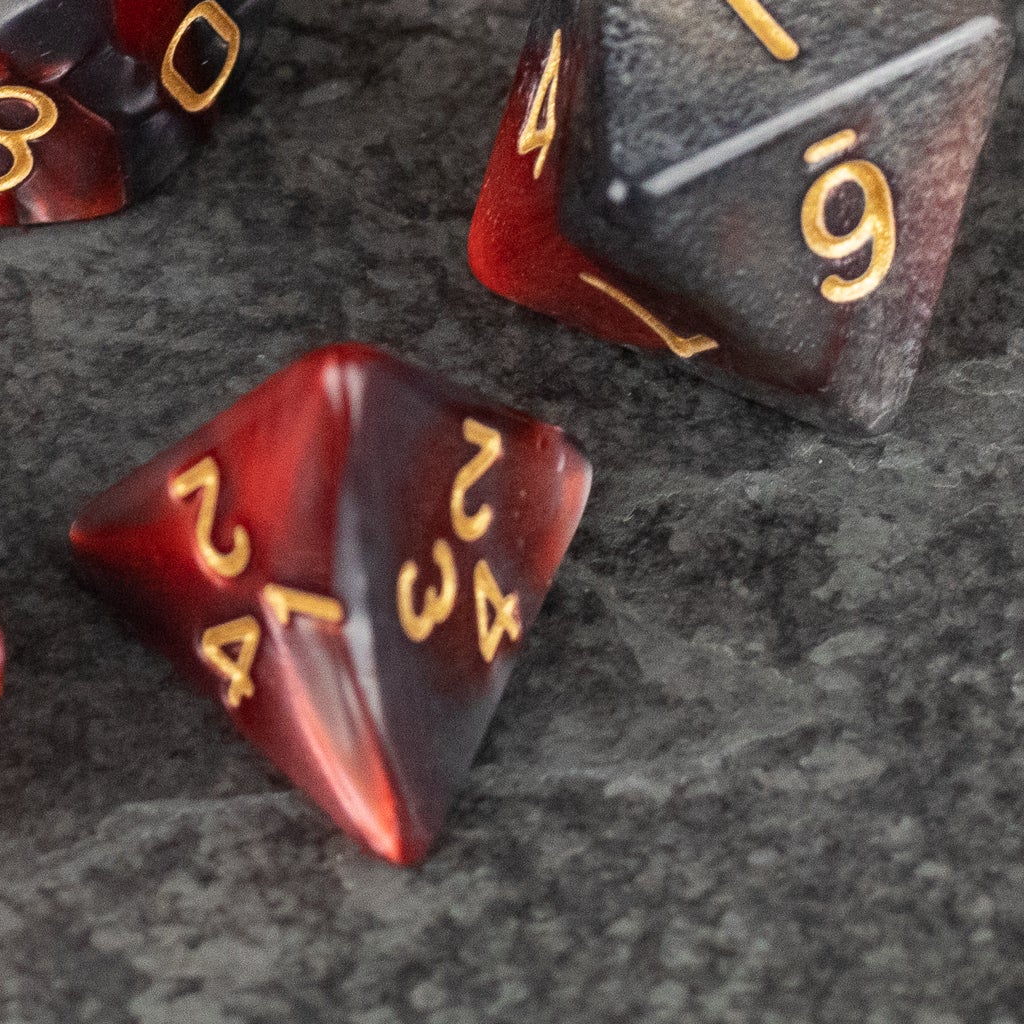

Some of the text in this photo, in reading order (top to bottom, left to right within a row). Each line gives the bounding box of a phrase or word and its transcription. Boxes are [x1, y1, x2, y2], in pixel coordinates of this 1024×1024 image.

[161, 0, 241, 113] 0
[517, 29, 562, 179] 4
[168, 456, 251, 578] 2
[450, 417, 504, 543] 2
[396, 538, 458, 643] 3
[472, 559, 521, 663] 4
[200, 615, 261, 708] 4
